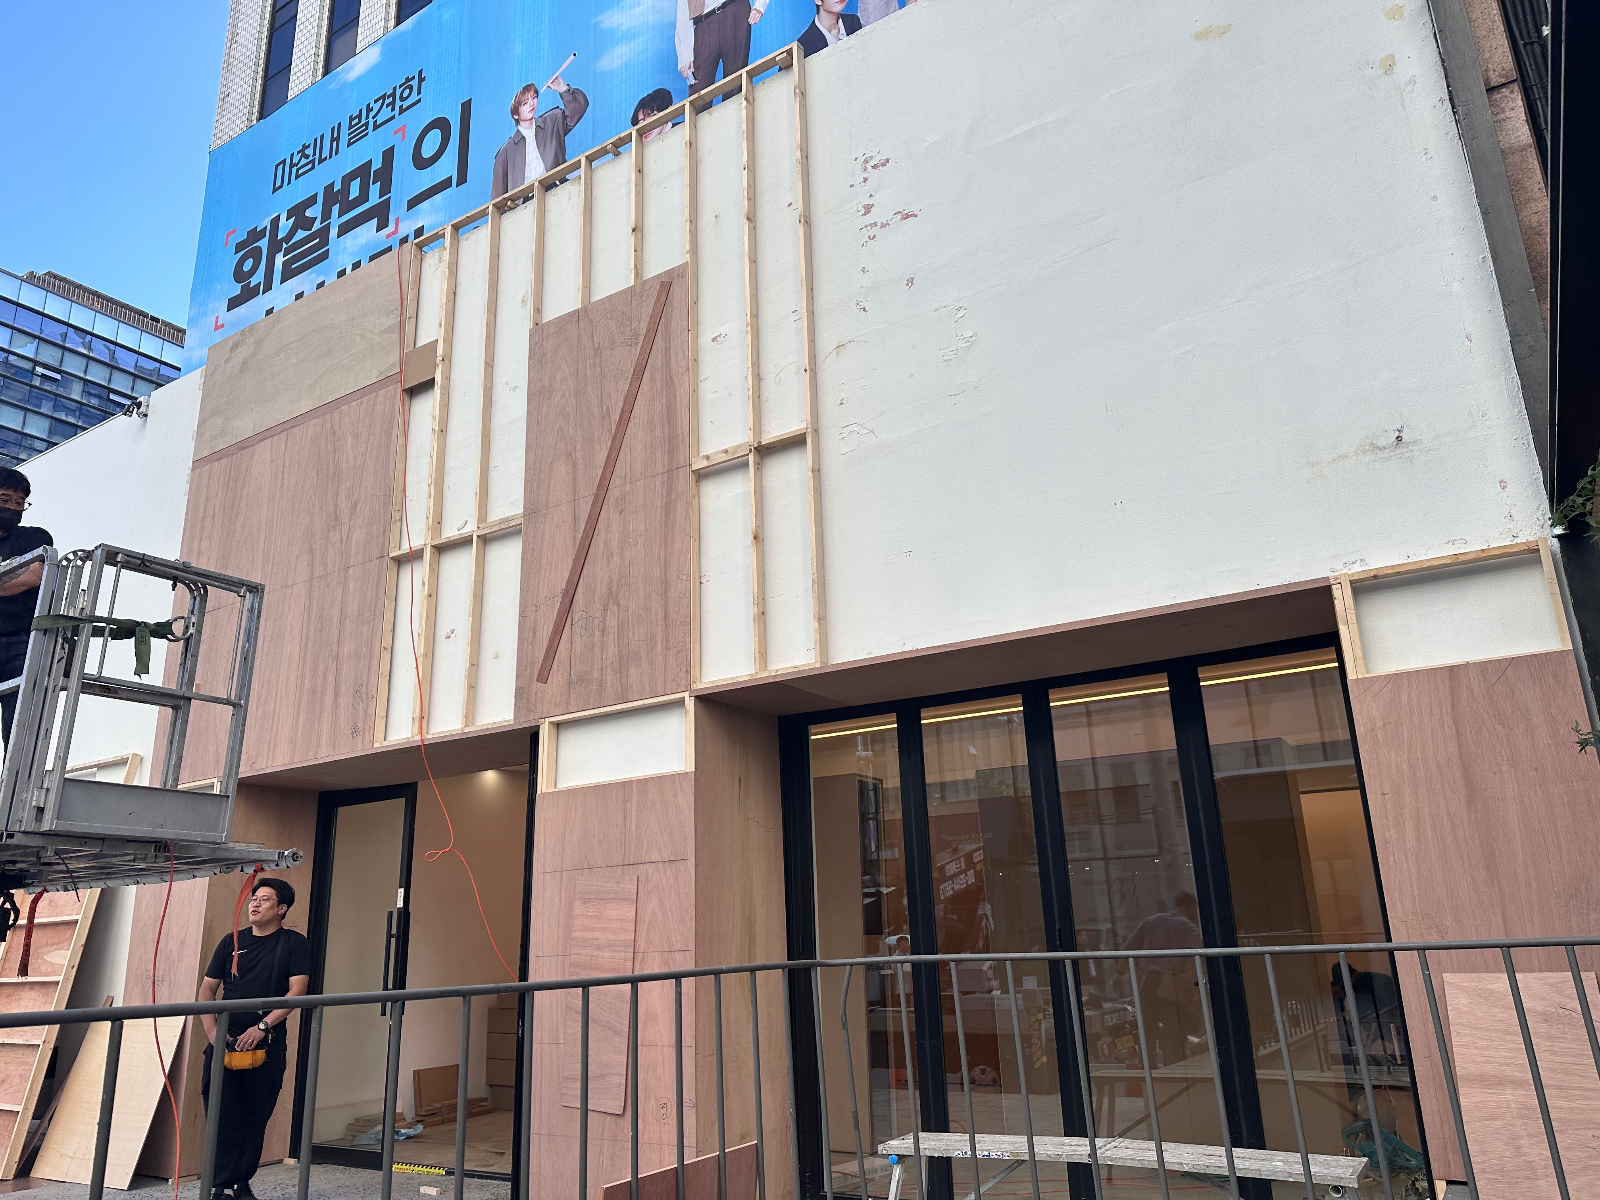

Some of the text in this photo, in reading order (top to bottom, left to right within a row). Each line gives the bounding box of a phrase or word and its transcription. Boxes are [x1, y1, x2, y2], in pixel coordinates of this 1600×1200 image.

[226, 143, 396, 313] 화잘먹
[405, 97, 473, 213] 의
[271, 68, 426, 195] 마침내 발견한
